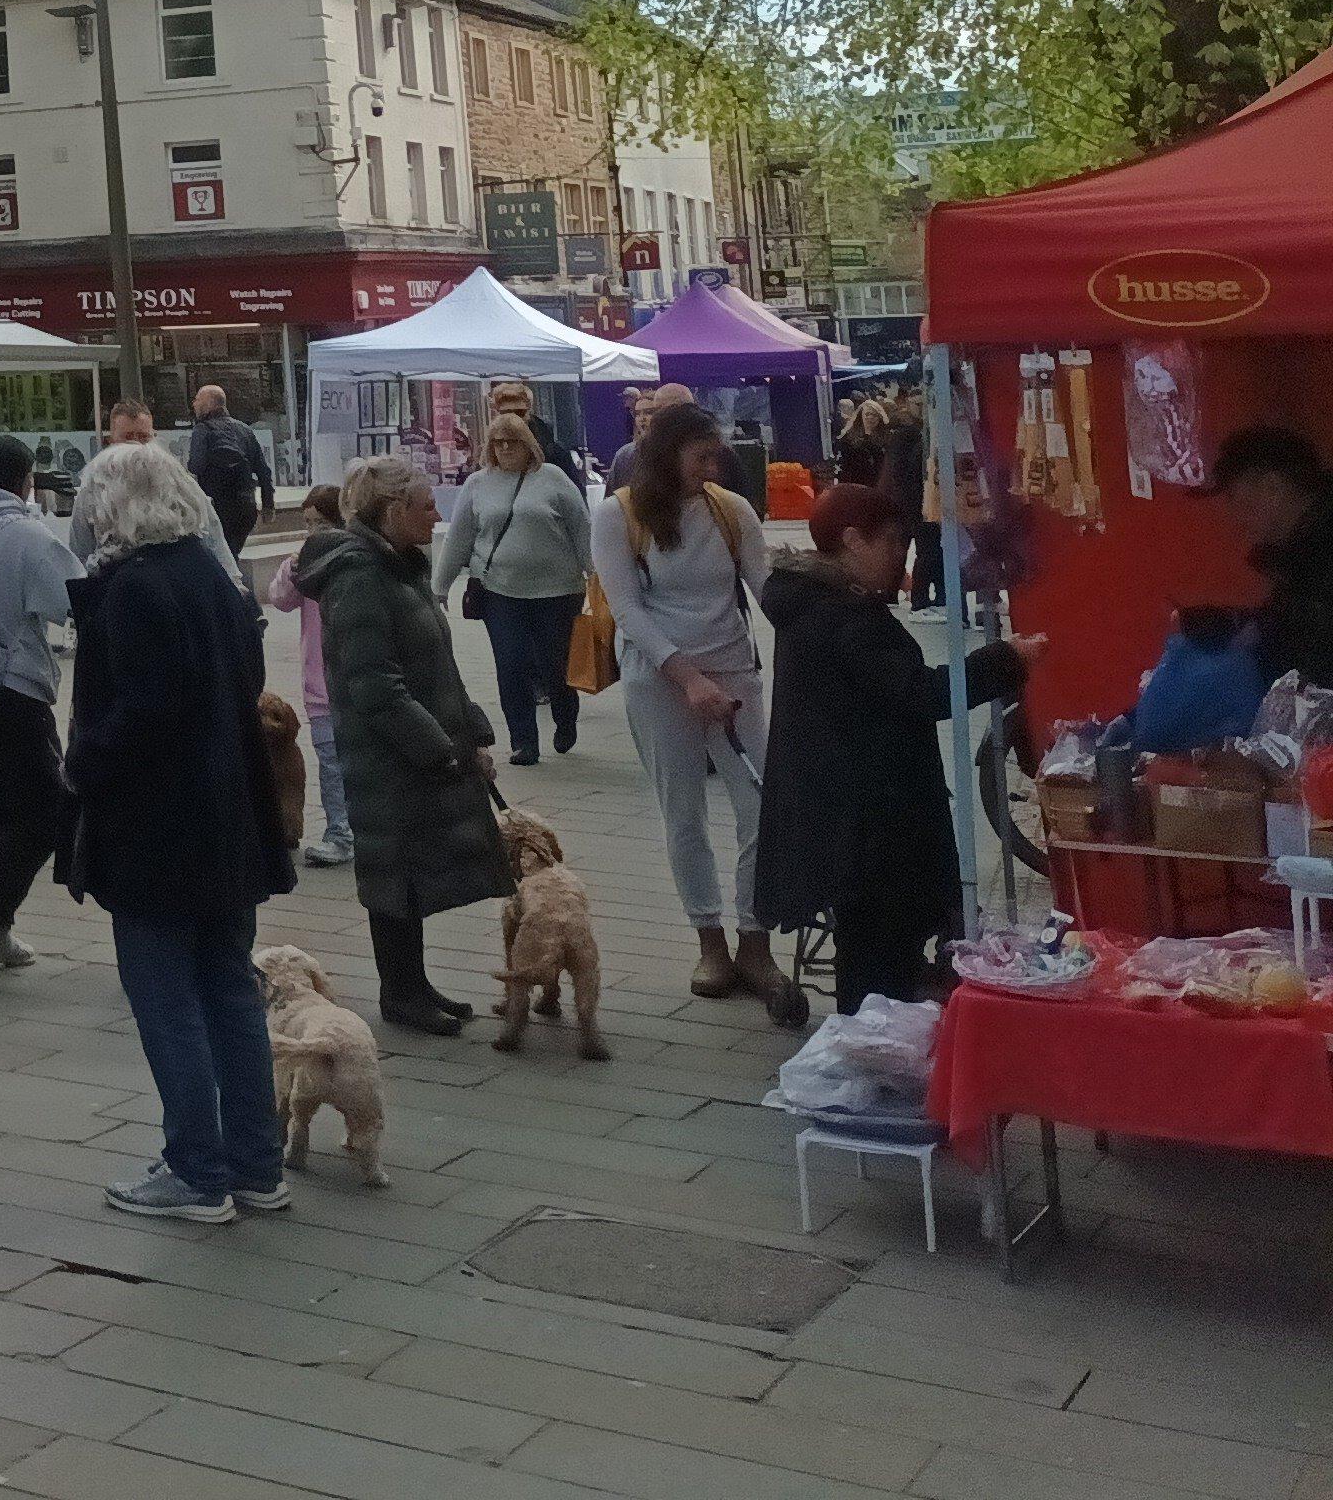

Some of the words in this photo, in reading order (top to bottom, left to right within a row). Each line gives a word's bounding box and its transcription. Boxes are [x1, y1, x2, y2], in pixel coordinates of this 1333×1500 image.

[493, 227, 549, 239] TWIST
[1115, 273, 1241, 302] husse
[259, 288, 293, 299] Repairs
[13, 297, 44, 307] Repairs
[239, 301, 284, 312] Engraving
